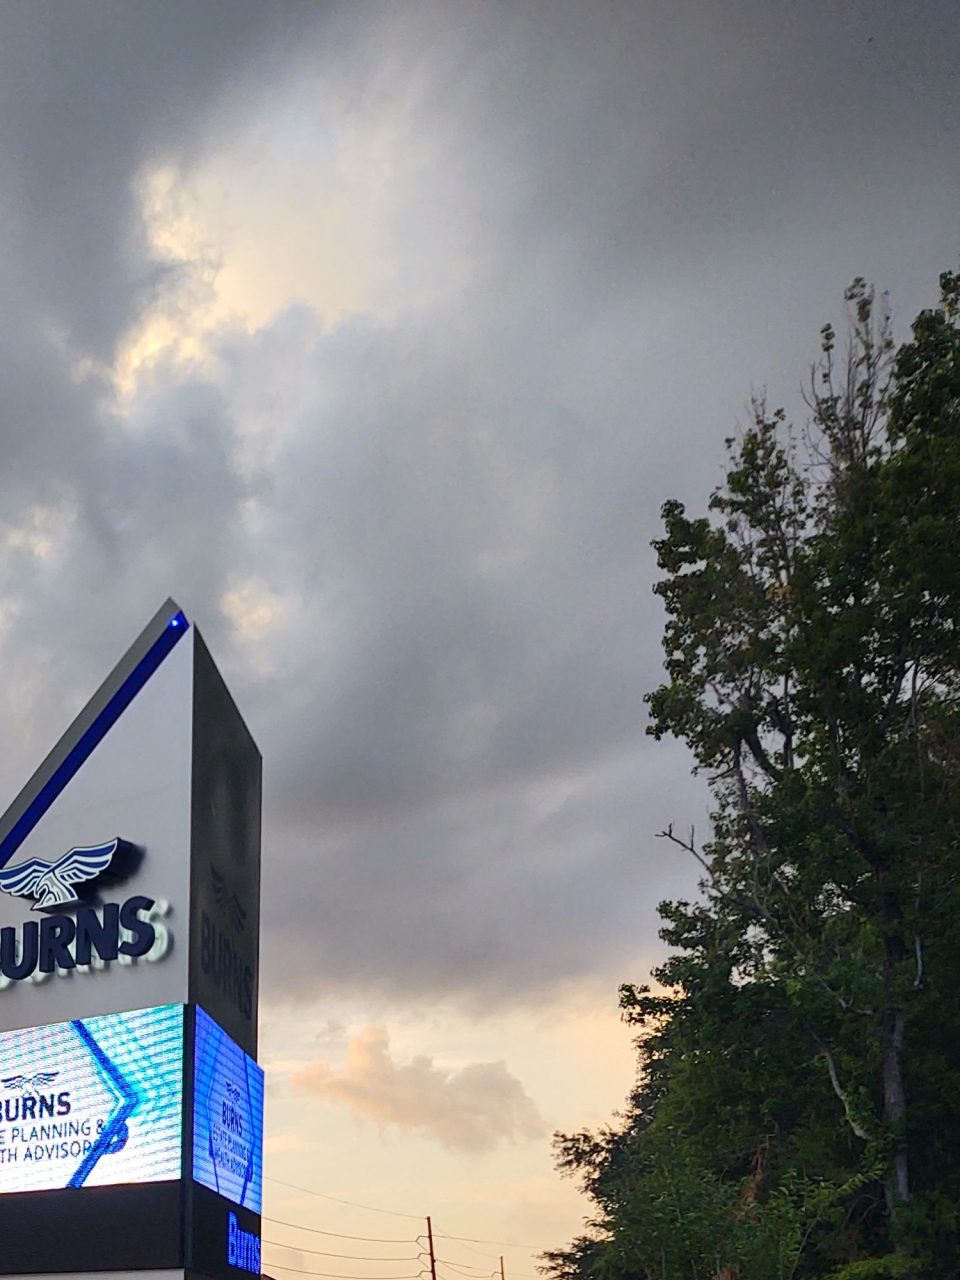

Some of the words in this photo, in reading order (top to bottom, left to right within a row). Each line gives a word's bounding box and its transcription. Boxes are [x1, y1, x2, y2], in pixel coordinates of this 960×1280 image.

[11, 1120, 91, 1144] PLANNING
[222, 1100, 243, 1138] BURNS
[23, 1140, 98, 1162] ADVISOR
[227, 1210, 262, 1275] Burns
